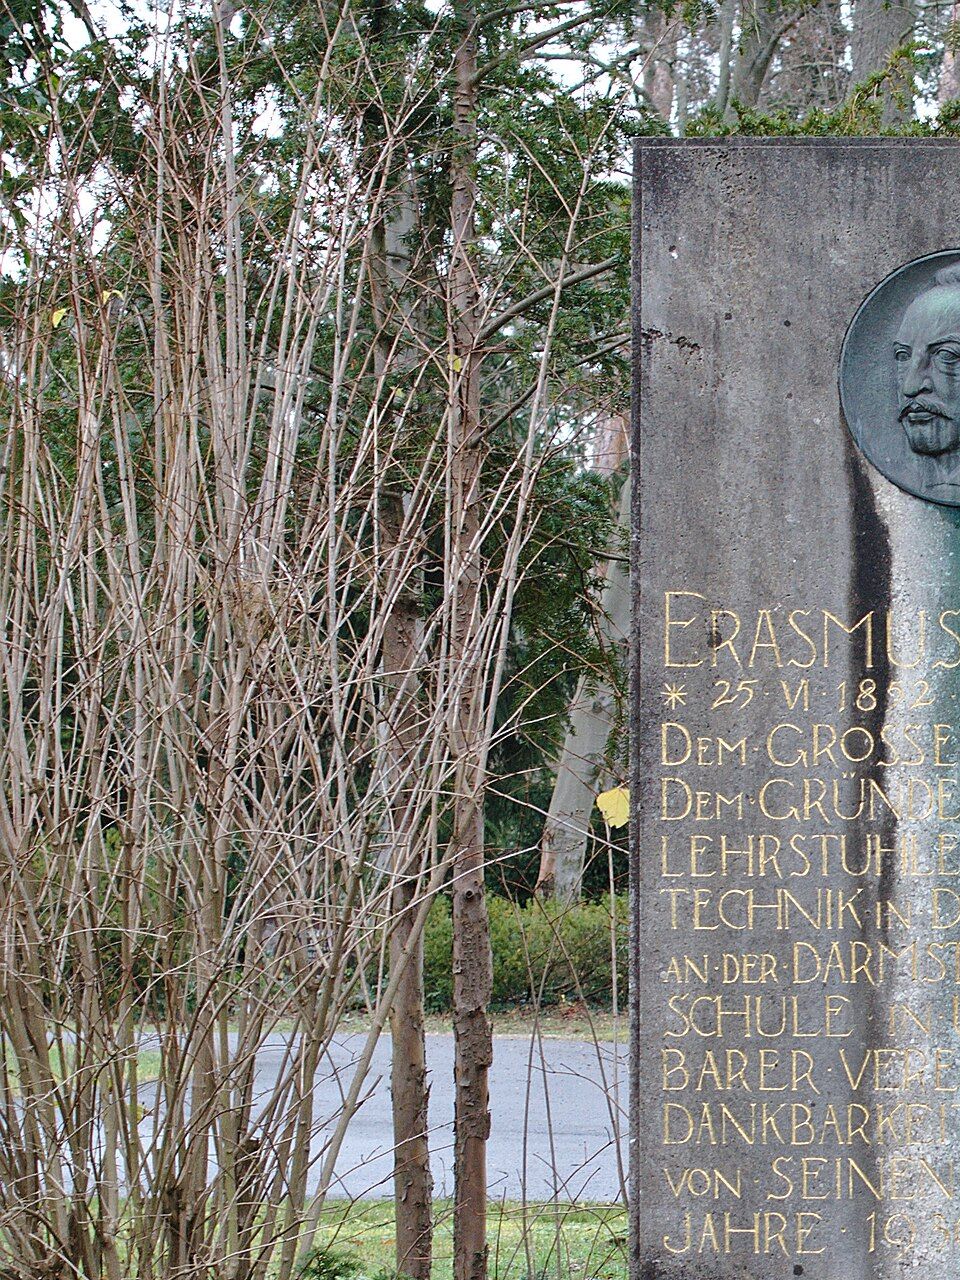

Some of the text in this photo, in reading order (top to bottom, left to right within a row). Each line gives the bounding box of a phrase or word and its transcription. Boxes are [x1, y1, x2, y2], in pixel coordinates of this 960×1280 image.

[712, 679, 753, 709] 25
[781, 680, 809, 710] VI
[838, 679, 936, 711] 1852
[661, 723, 747, 767] DEM
[661, 777, 744, 821] DEM
[660, 888, 864, 930] TECHNIK
[875, 898, 912, 929] IN
[662, 954, 710, 983] AN
[722, 954, 778, 985] DER
[663, 995, 851, 1038] SCHULE
[889, 1006, 932, 1037] IN
[662, 1050, 820, 1093] BARER
[663, 1170, 743, 1199] VON
[767, 1157, 954, 1201] SEINEN
[663, 1212, 823, 1256] JAHRE
